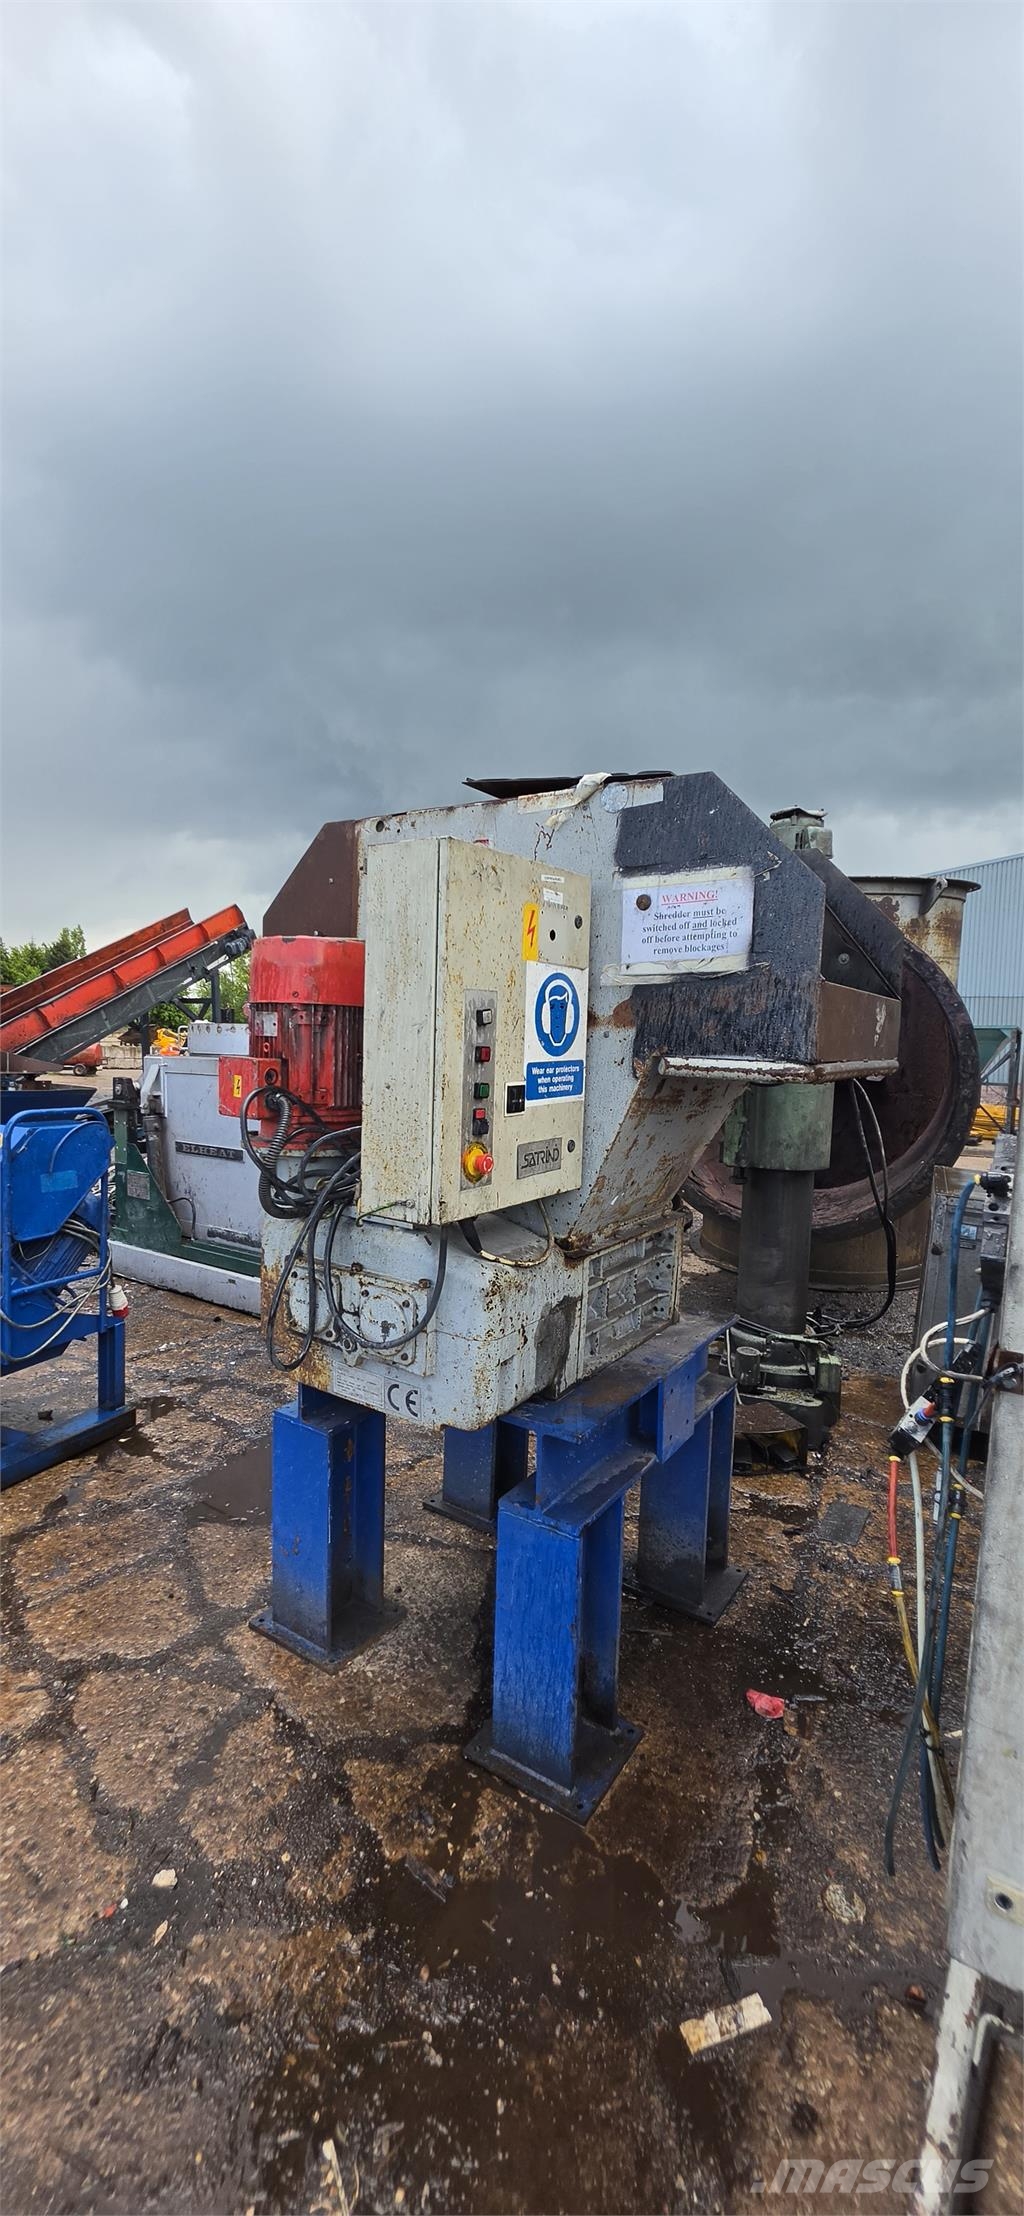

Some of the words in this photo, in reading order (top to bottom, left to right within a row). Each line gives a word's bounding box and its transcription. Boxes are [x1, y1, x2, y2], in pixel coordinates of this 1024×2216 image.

[661, 890, 718, 904] WARNING!
[653, 910, 690, 920] Shredder
[693, 908, 713, 918] must
[716, 906, 726, 915] be
[642, 922, 677, 932] switched
[678, 920, 690, 930] off
[692, 919, 708, 930] and
[710, 917, 737, 928] locked
[641, 935, 654, 944] off
[655, 933, 680, 943] before
[682, 929, 727, 942] attempting
[729, 930, 738, 938] to
[653, 946, 682, 955] remove
[684, 943, 725, 954] blockages
[531, 1066, 545, 1075] Wear
[556, 1065, 580, 1074] protectors
[538, 1075, 551, 1084] when
[552, 1074, 574, 1084] operating
[538, 1085, 548, 1093] this
[548, 1083, 573, 1092] machinery
[182, 1144, 235, 1158] ELHEAT
[387, 1383, 419, 1418] CE
